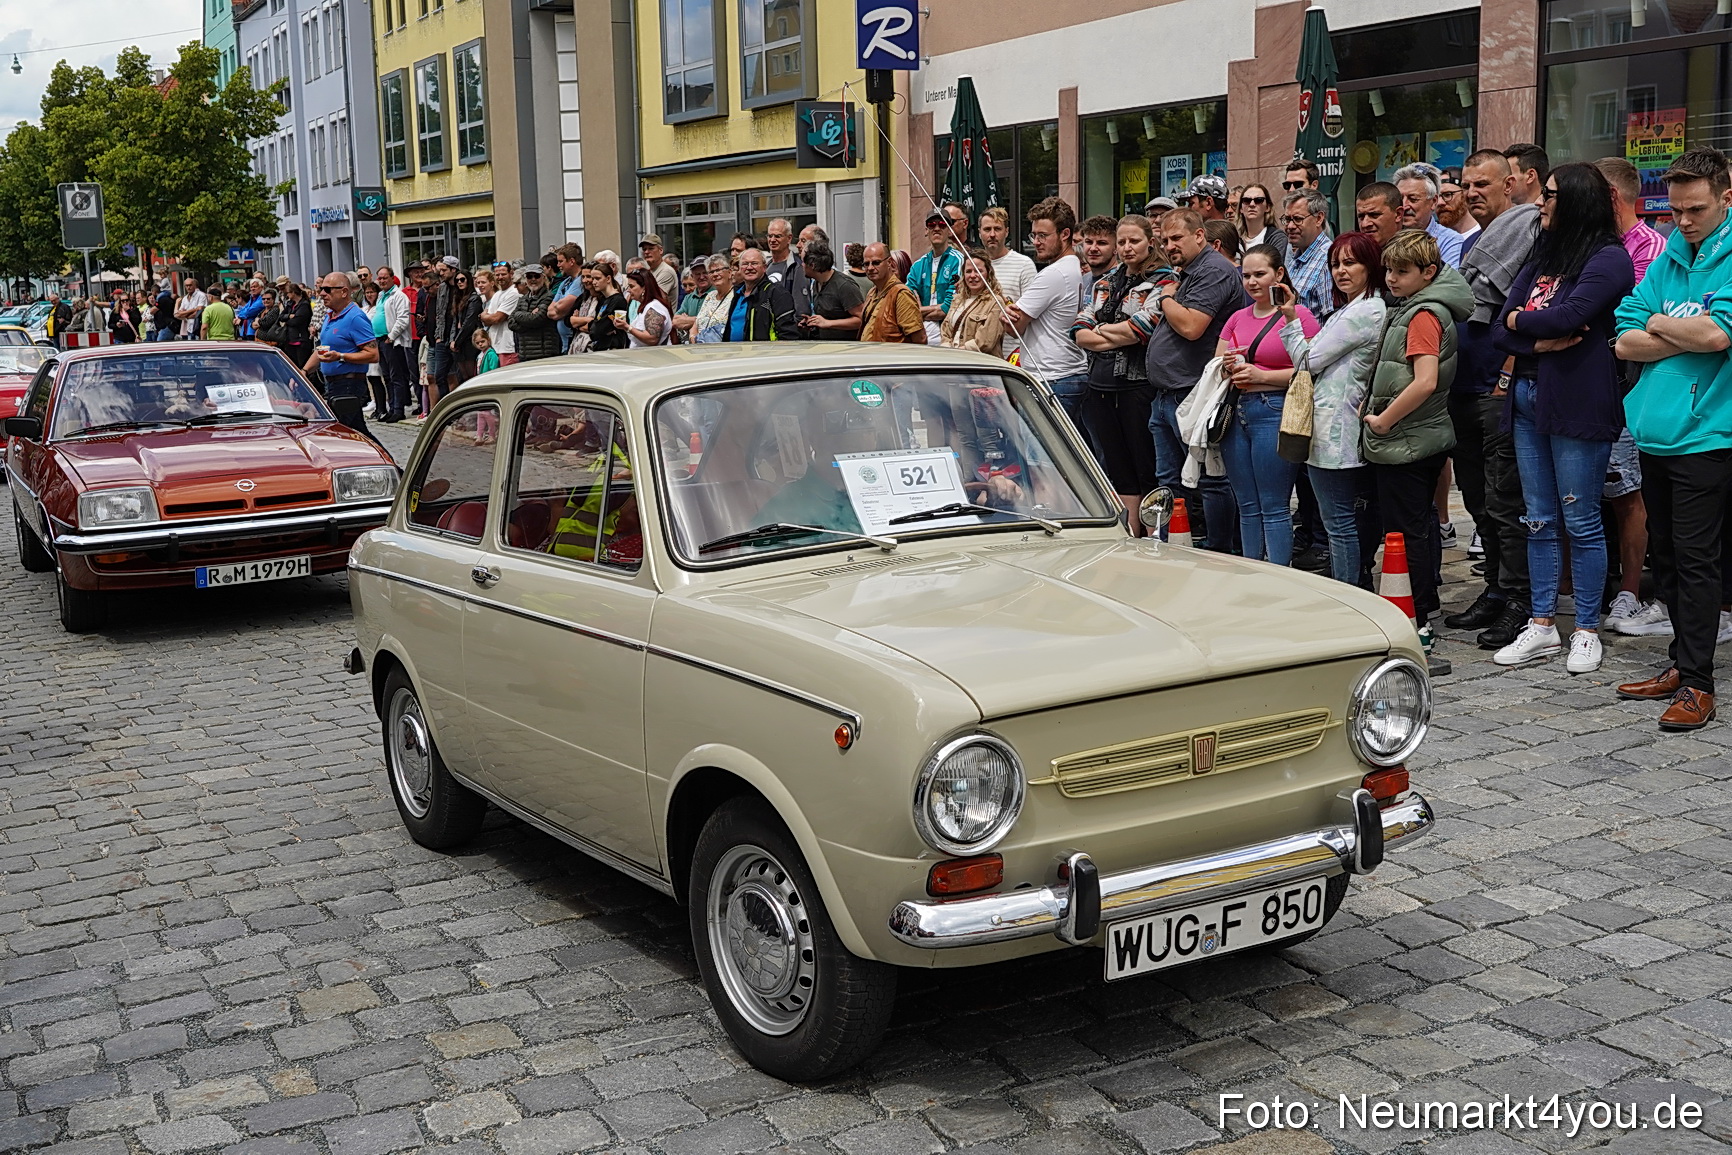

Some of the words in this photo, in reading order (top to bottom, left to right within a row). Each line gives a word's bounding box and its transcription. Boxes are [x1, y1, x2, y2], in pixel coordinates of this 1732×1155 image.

[925, 89, 947, 103] Unterer
[948, 86, 958, 99] Ma
[821, 119, 842, 146] G2
[1167, 157, 1187, 168] KOBR
[1124, 168, 1146, 183] KING
[365, 195, 377, 210] G2
[236, 388, 257, 399] 565
[900, 465, 938, 487] 521
[1197, 738, 1213, 769] FIAT
[1114, 901, 1247, 972] WUG-F
[1261, 884, 1322, 936] 850
